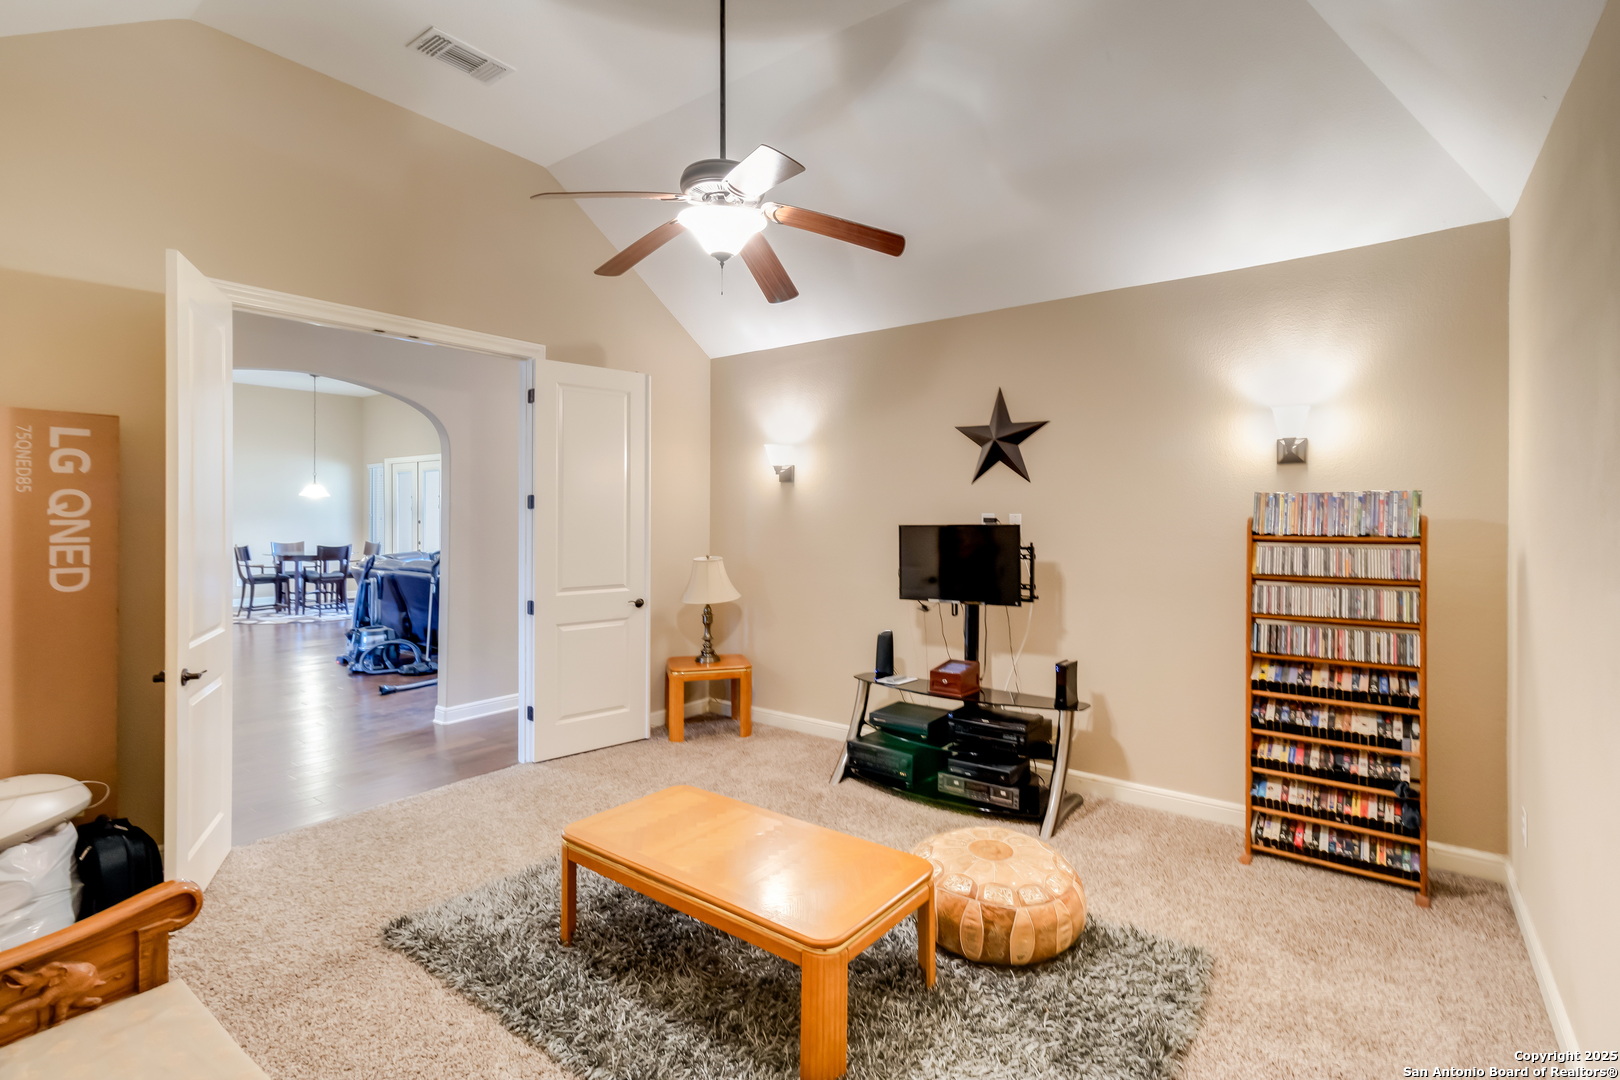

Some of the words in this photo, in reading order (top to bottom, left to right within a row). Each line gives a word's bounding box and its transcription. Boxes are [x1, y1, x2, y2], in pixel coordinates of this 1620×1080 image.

[14, 425, 33, 493] 75QNED85
[49, 426, 91, 474] LG
[47, 488, 91, 592] QNED
